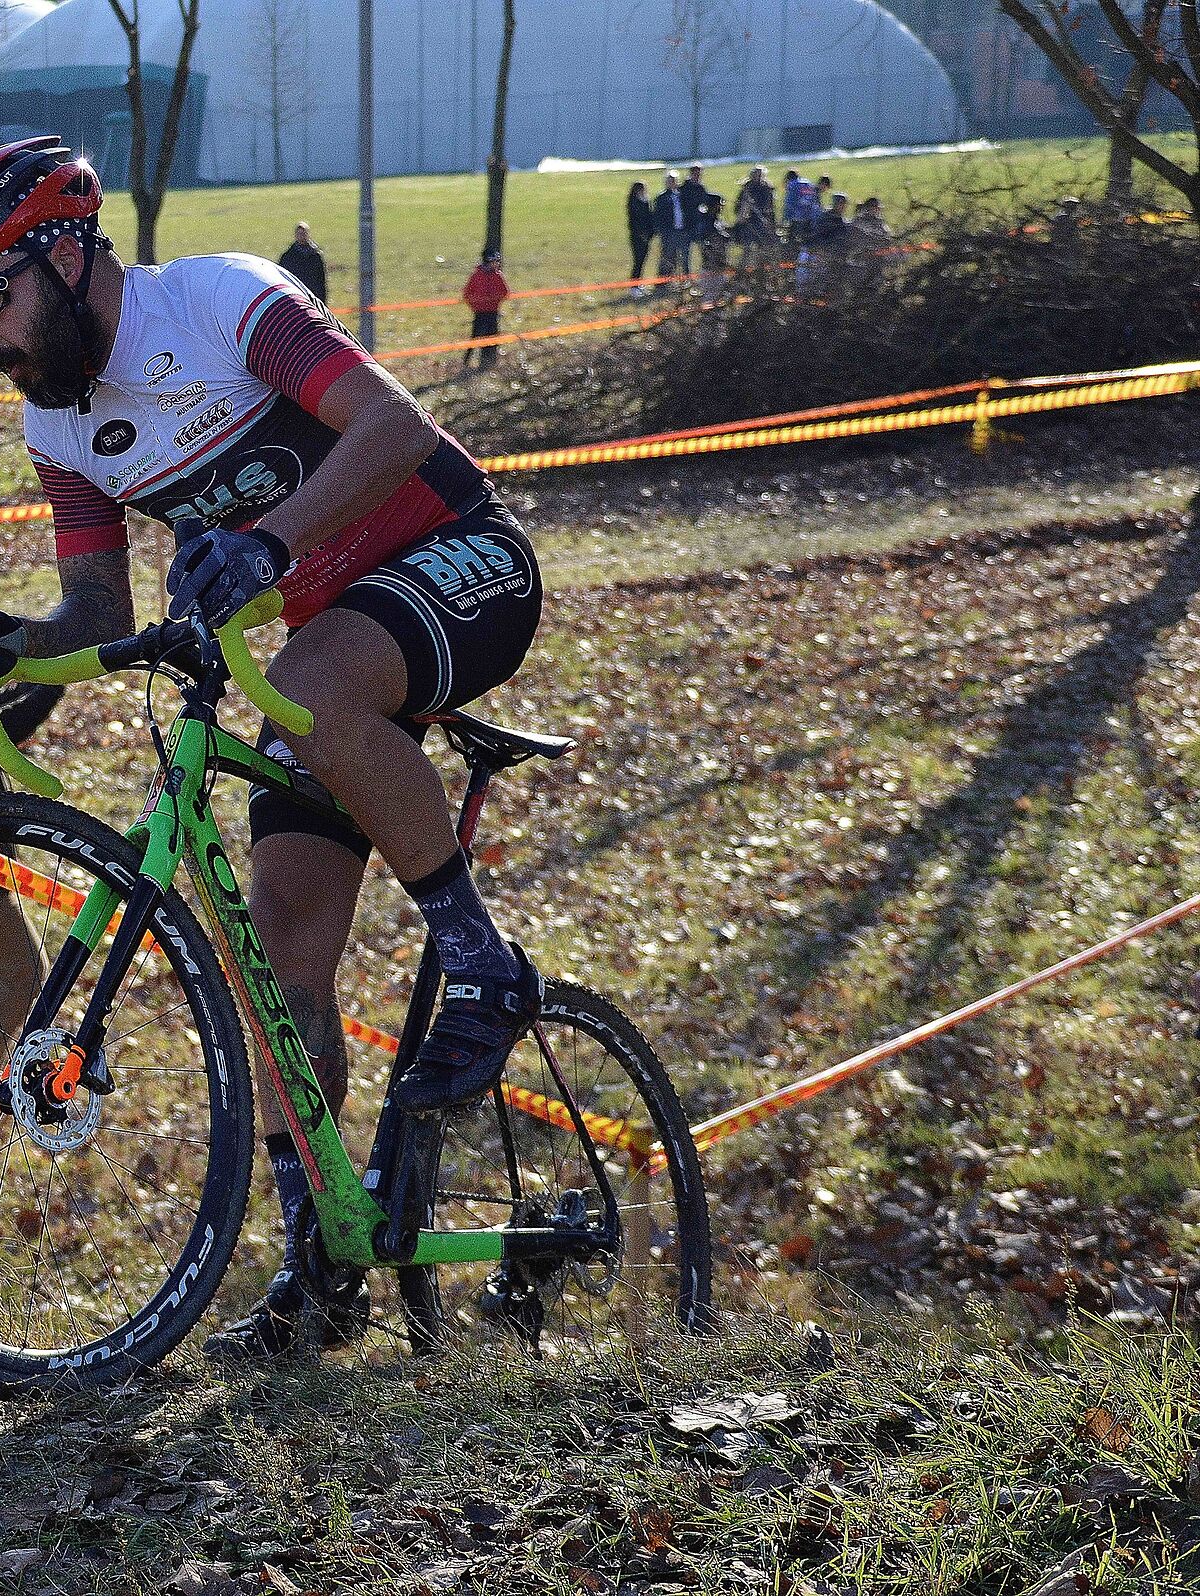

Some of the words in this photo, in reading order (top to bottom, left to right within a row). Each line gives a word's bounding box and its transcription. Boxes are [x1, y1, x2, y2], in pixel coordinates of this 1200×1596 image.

[402, 535, 514, 596] BHS
[455, 594, 479, 611] bike
[477, 584, 505, 603] house
[504, 575, 527, 593] store
[15, 823, 202, 976] FULCUM
[206, 841, 326, 1133] ORBEA
[445, 984, 482, 1000] SIDI
[47, 1223, 215, 1370] FULCRUM
